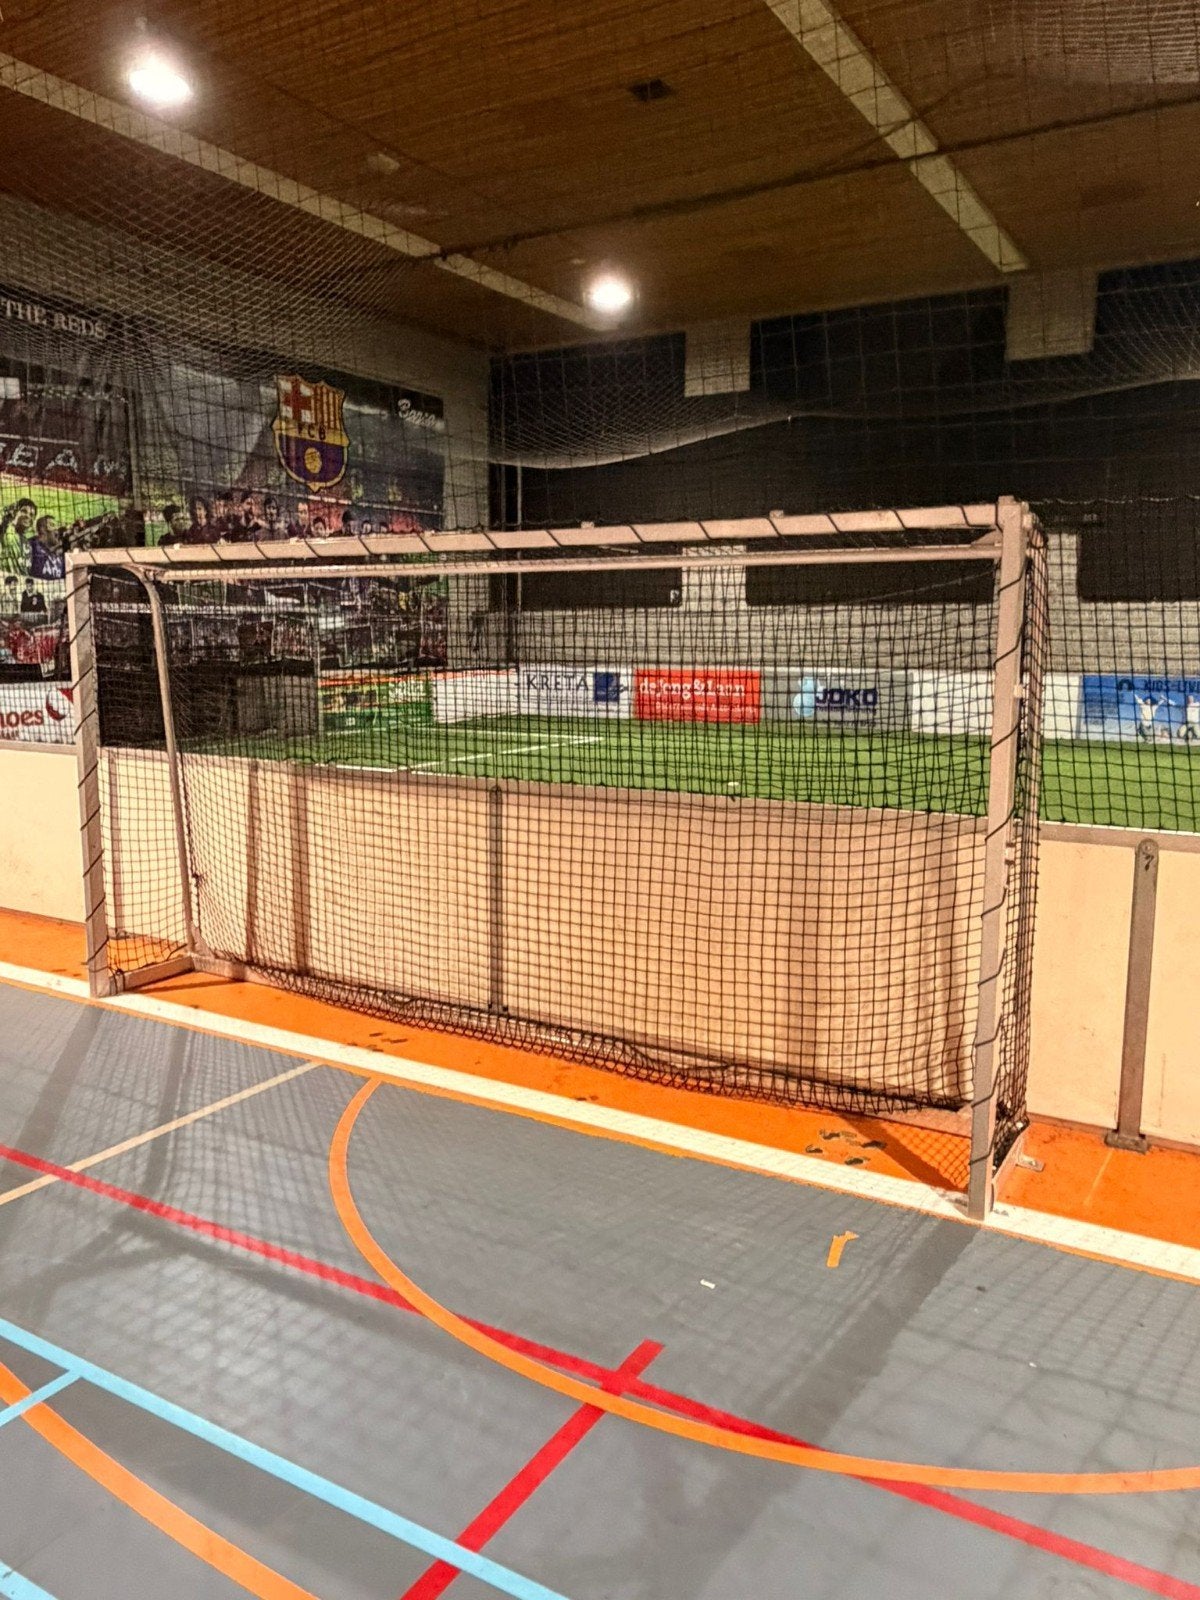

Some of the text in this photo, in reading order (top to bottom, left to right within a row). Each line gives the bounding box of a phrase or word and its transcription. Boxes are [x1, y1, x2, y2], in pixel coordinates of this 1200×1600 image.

[53, 312, 105, 339] REDS
[526, 673, 589, 691] KRETA
[815, 688, 877, 706] JOKO
